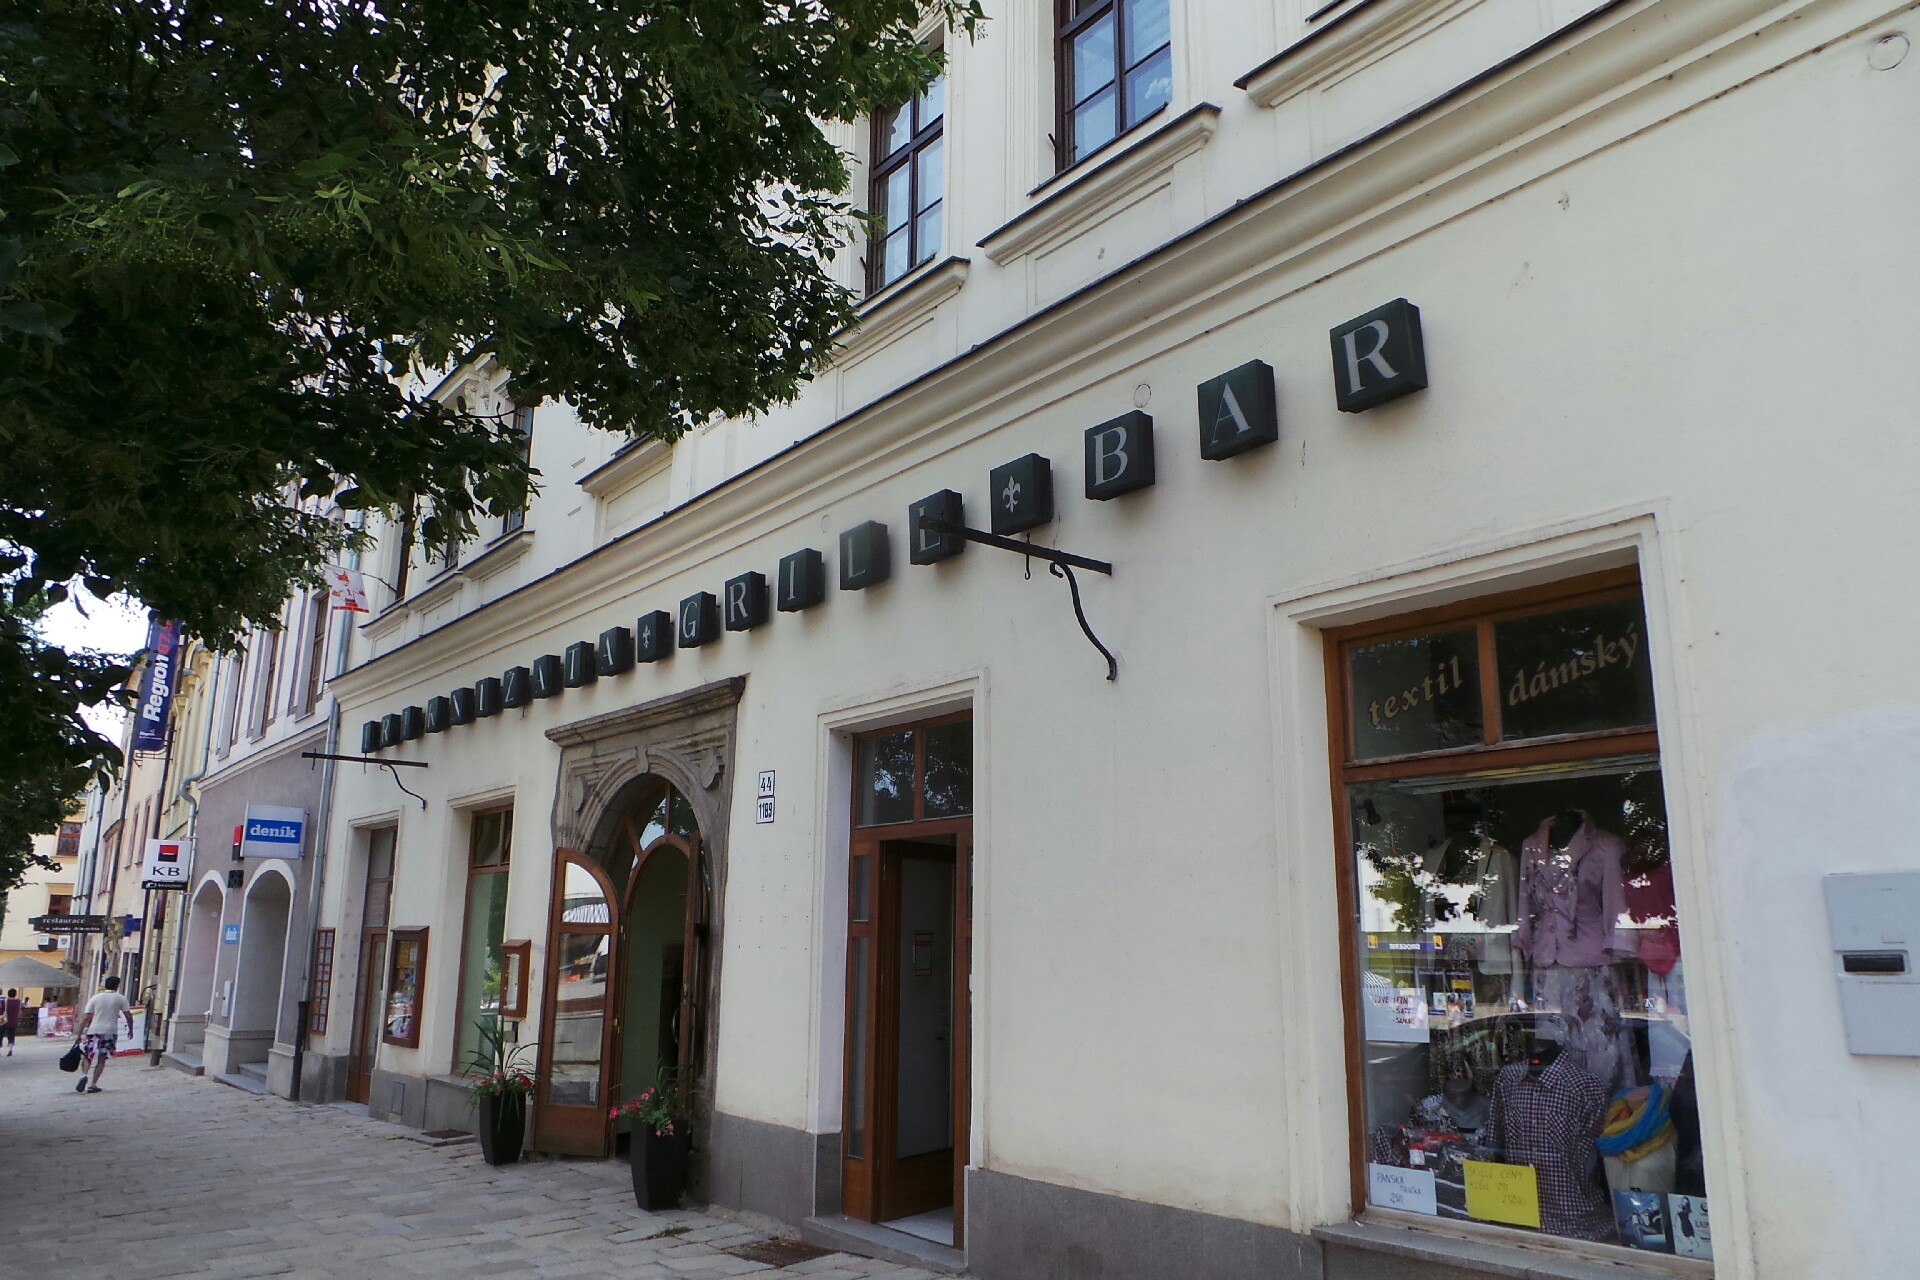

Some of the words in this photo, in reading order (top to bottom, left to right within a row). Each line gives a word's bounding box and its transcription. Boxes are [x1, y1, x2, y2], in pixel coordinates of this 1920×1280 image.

[682, 505, 941, 639] GRILL
[1093, 318, 1400, 487] BAR
[143, 653, 169, 722] Region
[1368, 656, 1463, 726] textil
[1509, 622, 1639, 708] dámský
[760, 777, 772, 792] 44
[250, 824, 296, 838] deník
[151, 865, 181, 877] KB
